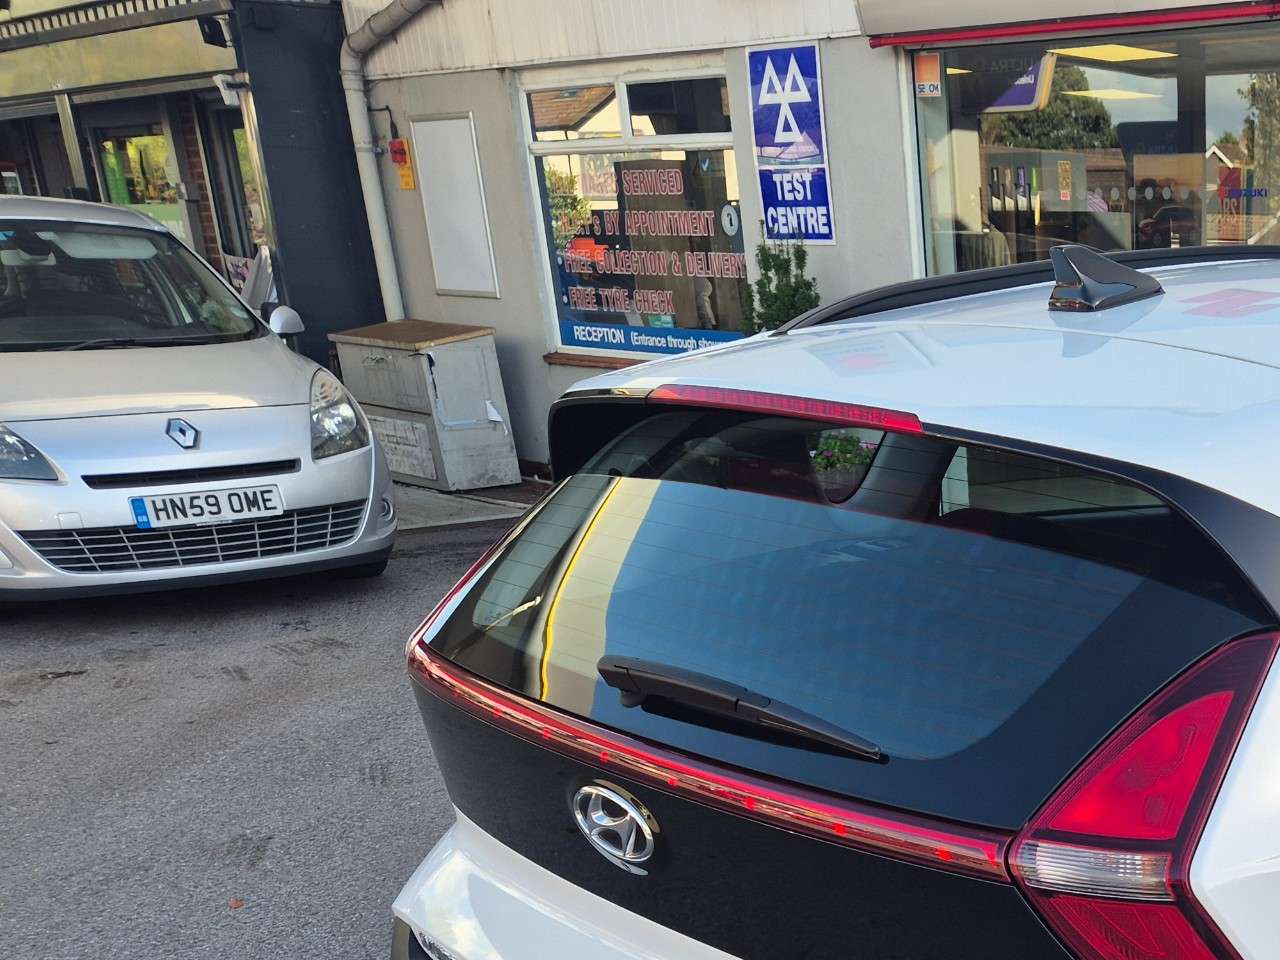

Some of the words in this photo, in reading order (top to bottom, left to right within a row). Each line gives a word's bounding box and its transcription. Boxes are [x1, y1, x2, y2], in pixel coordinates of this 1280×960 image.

[623, 169, 684, 195] SERVICED
[772, 173, 812, 201] TEST
[603, 210, 621, 236] BY
[625, 211, 715, 237] APPOINTMENT
[767, 206, 830, 234] CENTRE
[565, 250, 593, 273] FREE
[596, 250, 668, 277] COLLECTION
[671, 253, 682, 277] &
[685, 252, 746, 279] DELIVERY
[569, 286, 598, 311] FREE
[601, 288, 631, 313] TYRE
[634, 290, 676, 315] CHECK
[573, 325, 625, 344] RECEPTION
[630, 331, 666, 347] (Entrance
[667, 334, 697, 351] through
[152, 495, 222, 521] HN59
[228, 489, 277, 514] OME
